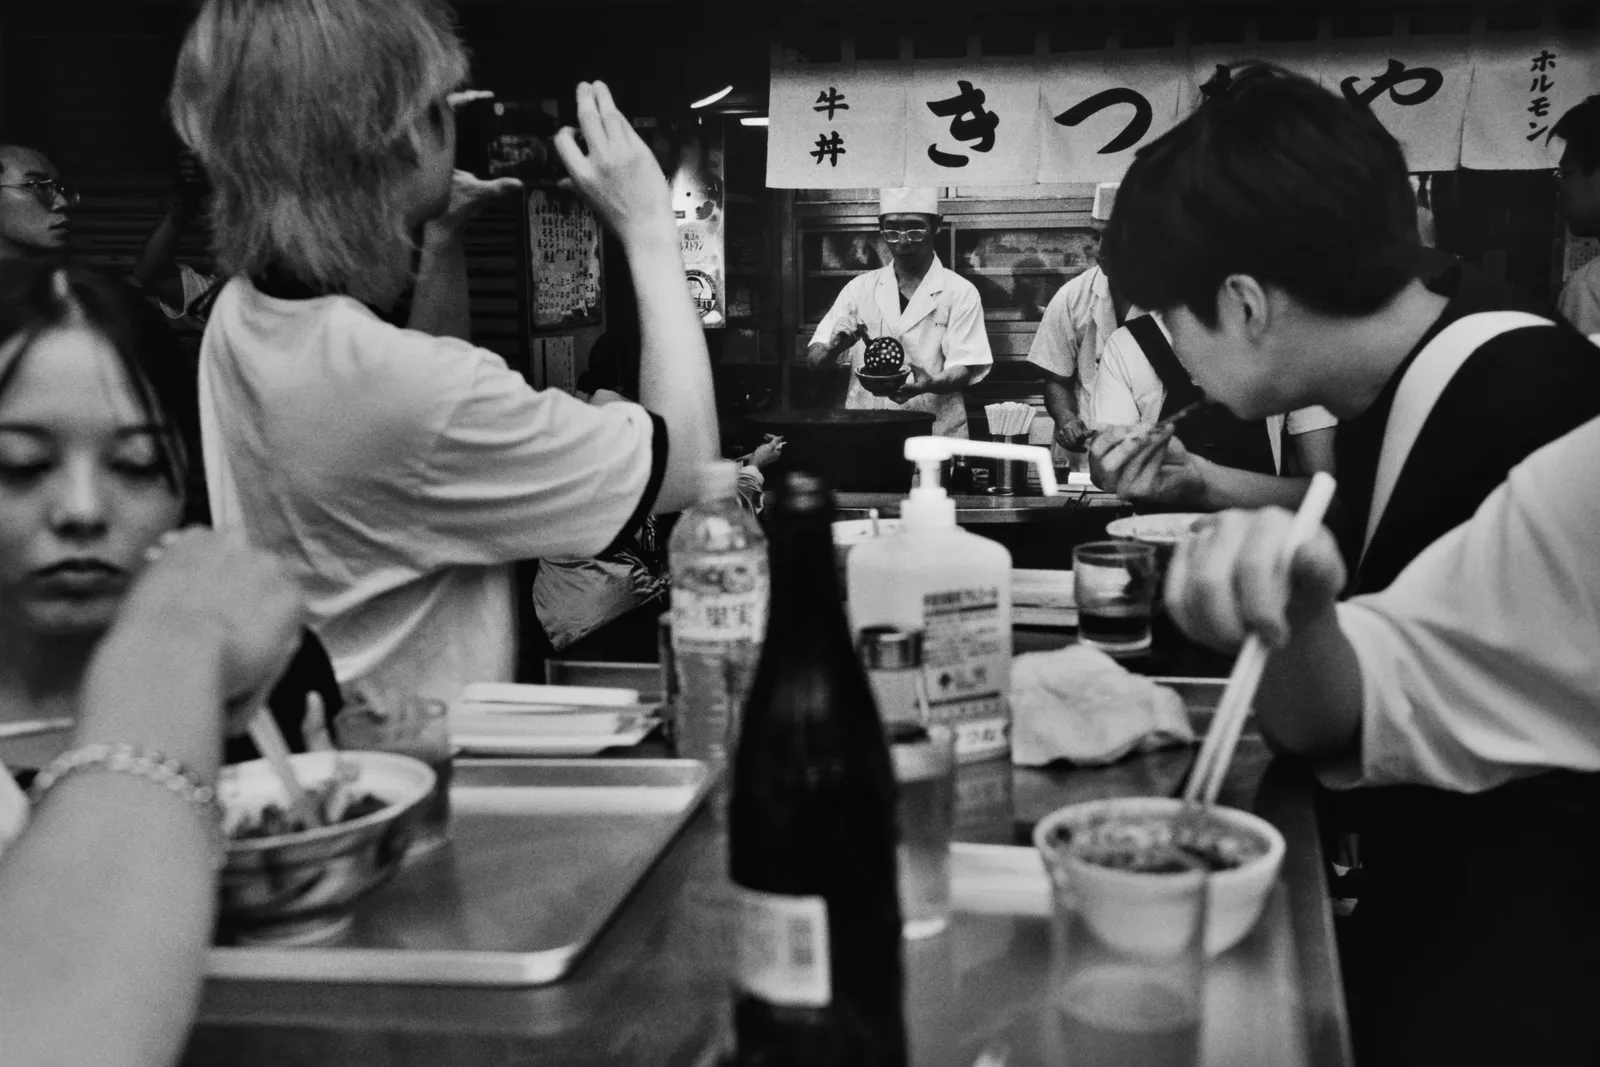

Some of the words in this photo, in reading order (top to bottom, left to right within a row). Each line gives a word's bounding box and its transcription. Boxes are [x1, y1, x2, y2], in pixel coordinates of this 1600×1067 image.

[810, 86, 850, 168] 牛丼
[1526, 49, 1556, 142] ホルモン
